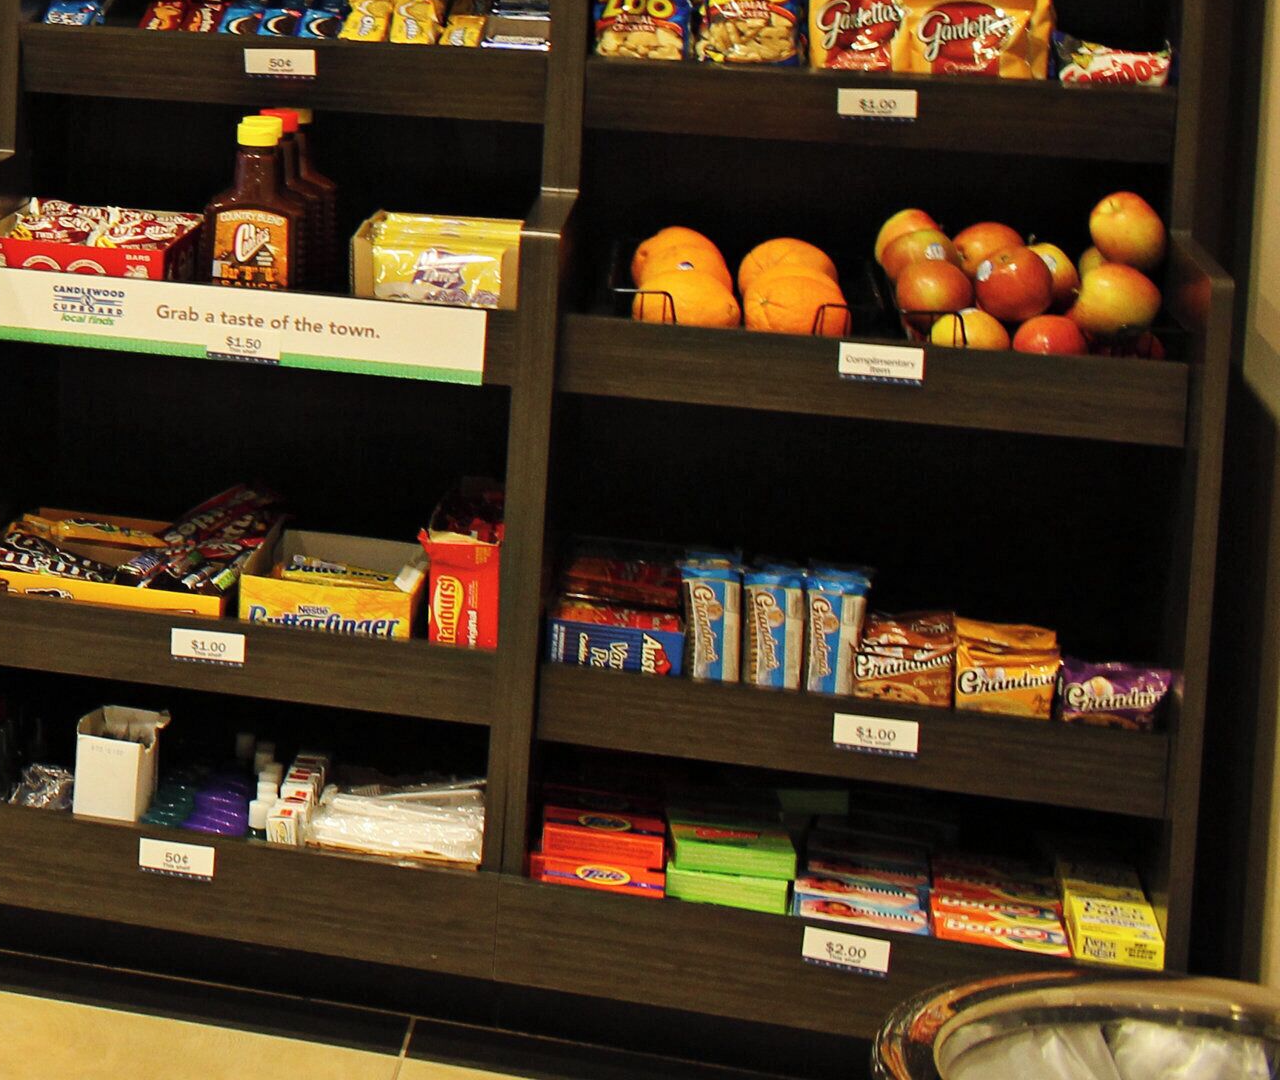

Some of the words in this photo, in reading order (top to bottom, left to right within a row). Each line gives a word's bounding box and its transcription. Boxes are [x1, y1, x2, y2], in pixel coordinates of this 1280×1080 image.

[269, 58, 294, 69] 50¢
[857, 98, 898, 112] $1.00
[52, 284, 126, 298] CANDLEWOOD
[52, 302, 125, 316] CUPBOARD
[60, 313, 86, 324] local
[87, 314, 115, 326] finds
[156, 304, 200, 323] Grab
[205, 312, 216, 324] a
[221, 312, 265, 329] taste
[269, 314, 291, 331] of
[294, 316, 324, 333] the
[329, 320, 381, 339] town.
[225, 335, 263, 351] $1.50
[845, 354, 916, 369] Complimentary
[438, 574, 456, 646] tarburst
[190, 638, 227, 653] $1.00
[855, 725, 898, 743] $1.00
[165, 852, 192, 865] 50¢
[825, 941, 867, 960] $2.00
